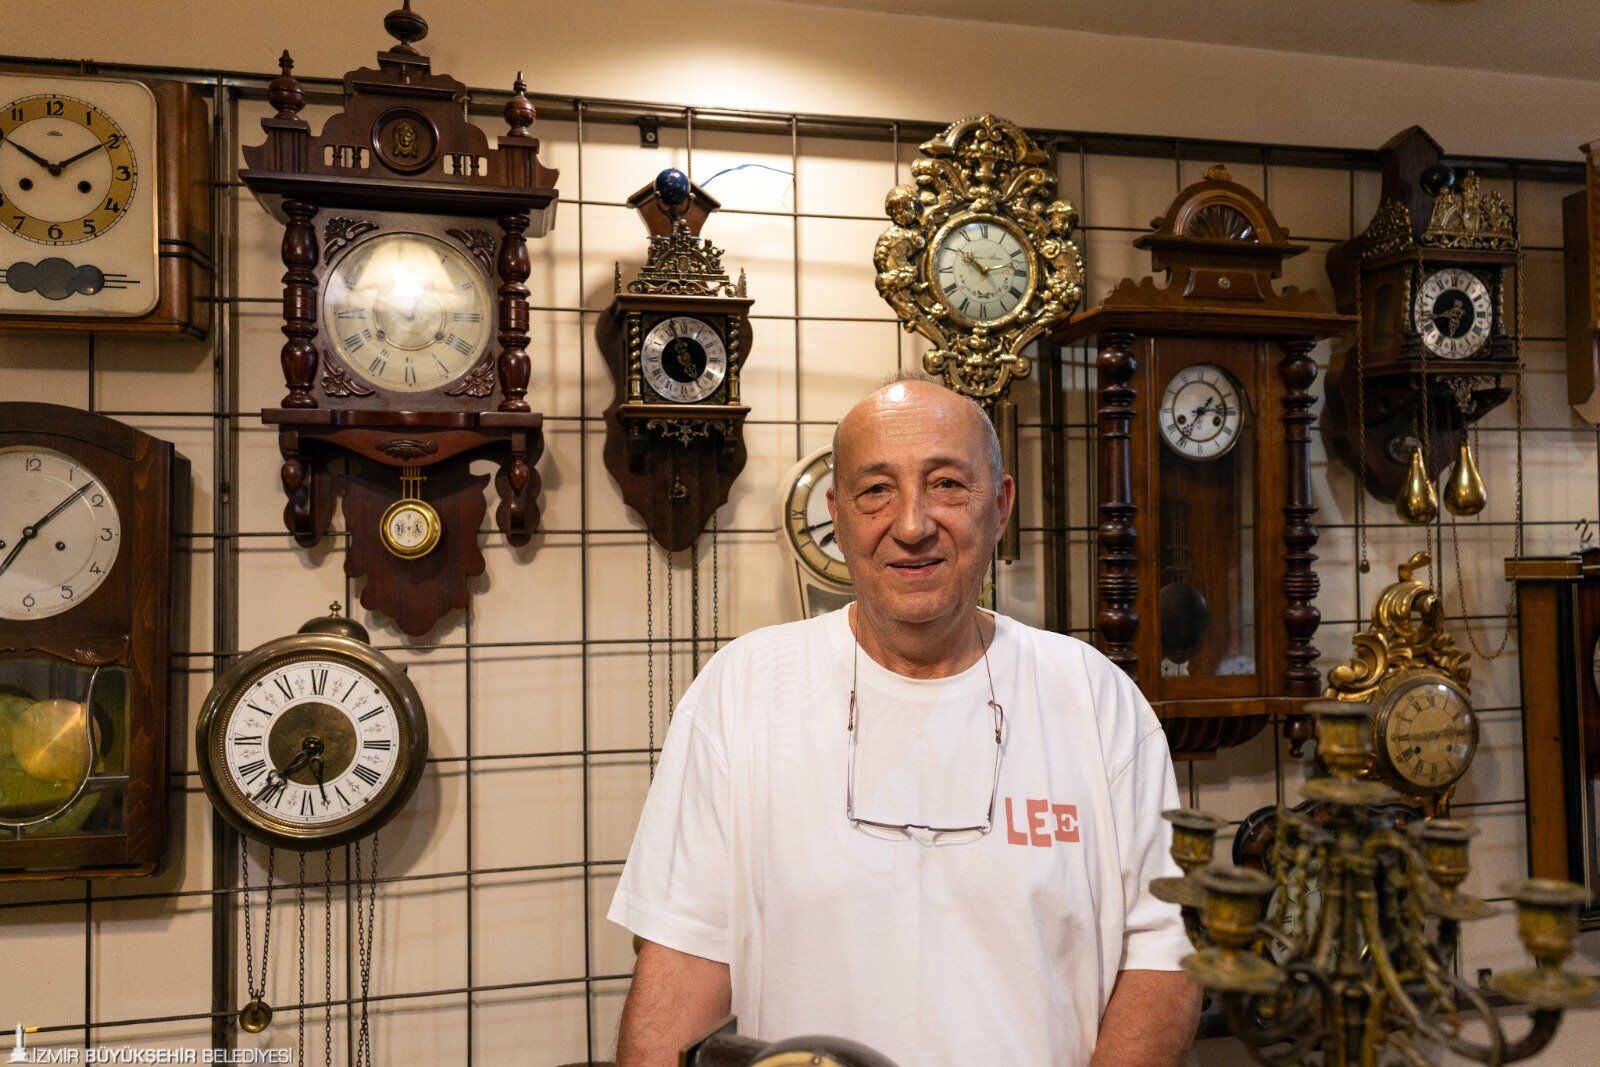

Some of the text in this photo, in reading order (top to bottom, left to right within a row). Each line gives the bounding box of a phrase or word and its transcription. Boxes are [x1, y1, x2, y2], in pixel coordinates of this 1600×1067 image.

[11, 109, 23, 121] 11
[46, 101, 63, 116] 12
[85, 111, 91, 125] 1
[109, 134, 120, 149] 2
[115, 166, 131, 181] 3
[105, 198, 120, 213] 4
[13, 216, 26, 231] 7
[84, 220, 96, 234] 5
[48, 225, 62, 239] 6
[26, 459, 41, 471] 12
[69, 469, 73, 481] 1
[92, 494, 103, 507] 2
[101, 529, 112, 541] 3
[90, 562, 102, 574] 4
[61, 586, 73, 600] 5
[23, 594, 34, 607] 6
[1005, 797, 1080, 847] LEE
